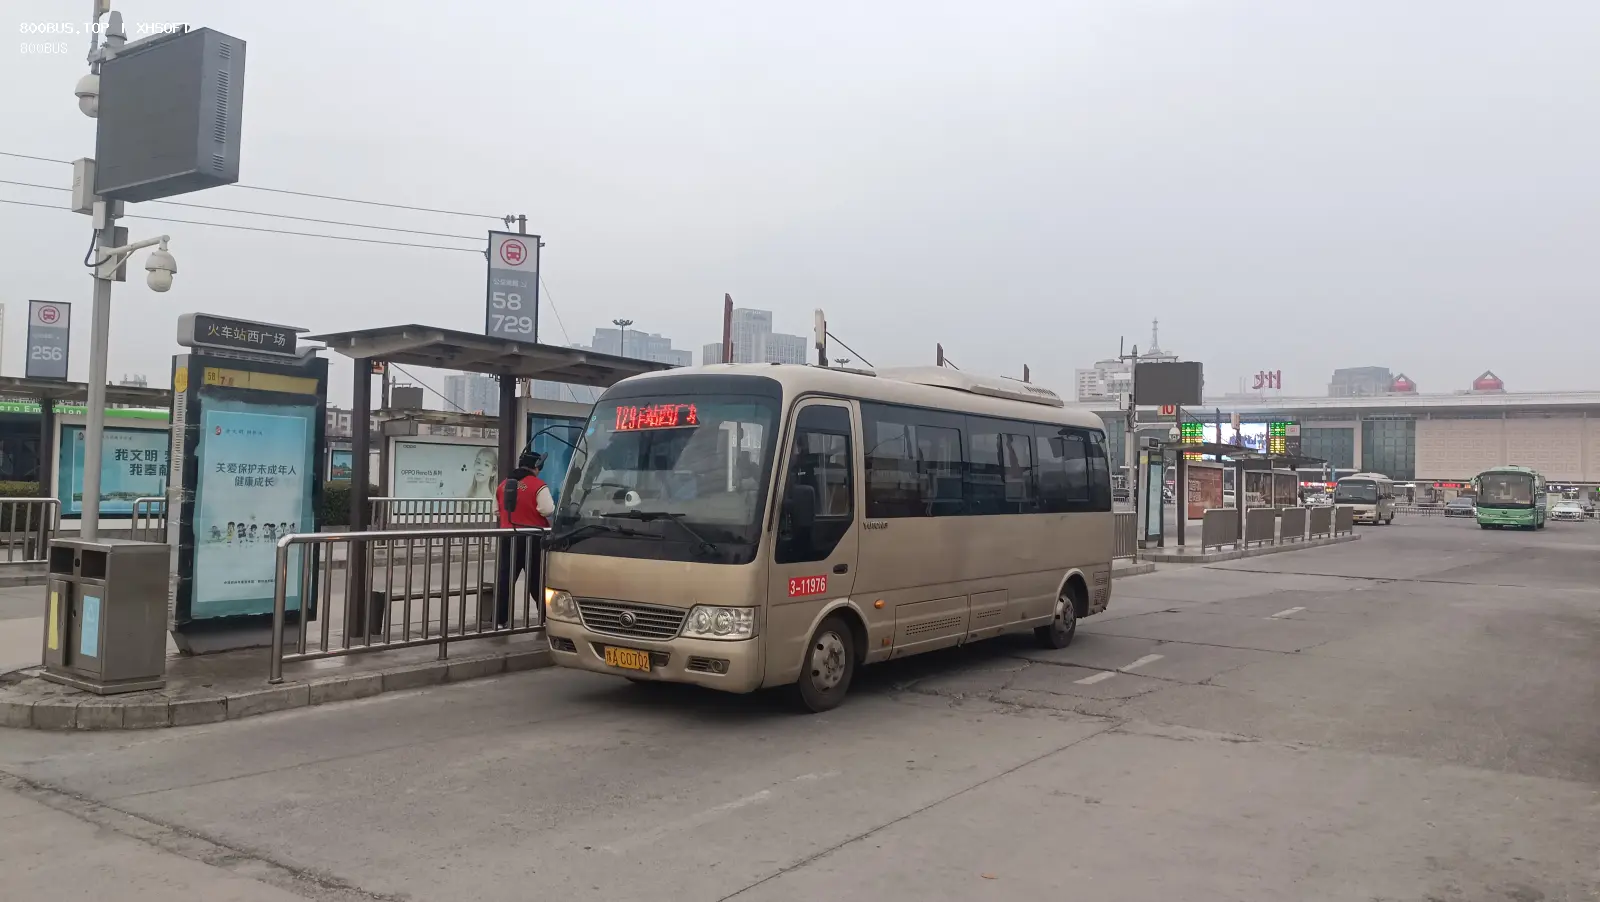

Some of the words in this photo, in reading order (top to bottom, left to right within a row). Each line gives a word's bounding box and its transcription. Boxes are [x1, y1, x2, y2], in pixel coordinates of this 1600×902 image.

[492, 291, 522, 311] 58
[491, 313, 533, 334] 729
[207, 322, 286, 347] 火车站西广场
[31, 345, 62, 361] 256
[1251, 369, 1282, 390] 州
[115, 448, 158, 461] 我文明
[215, 462, 297, 476] 关爱保护未成年人
[234, 476, 275, 487] 健康成长
[790, 577, 826, 595] 3-11976
